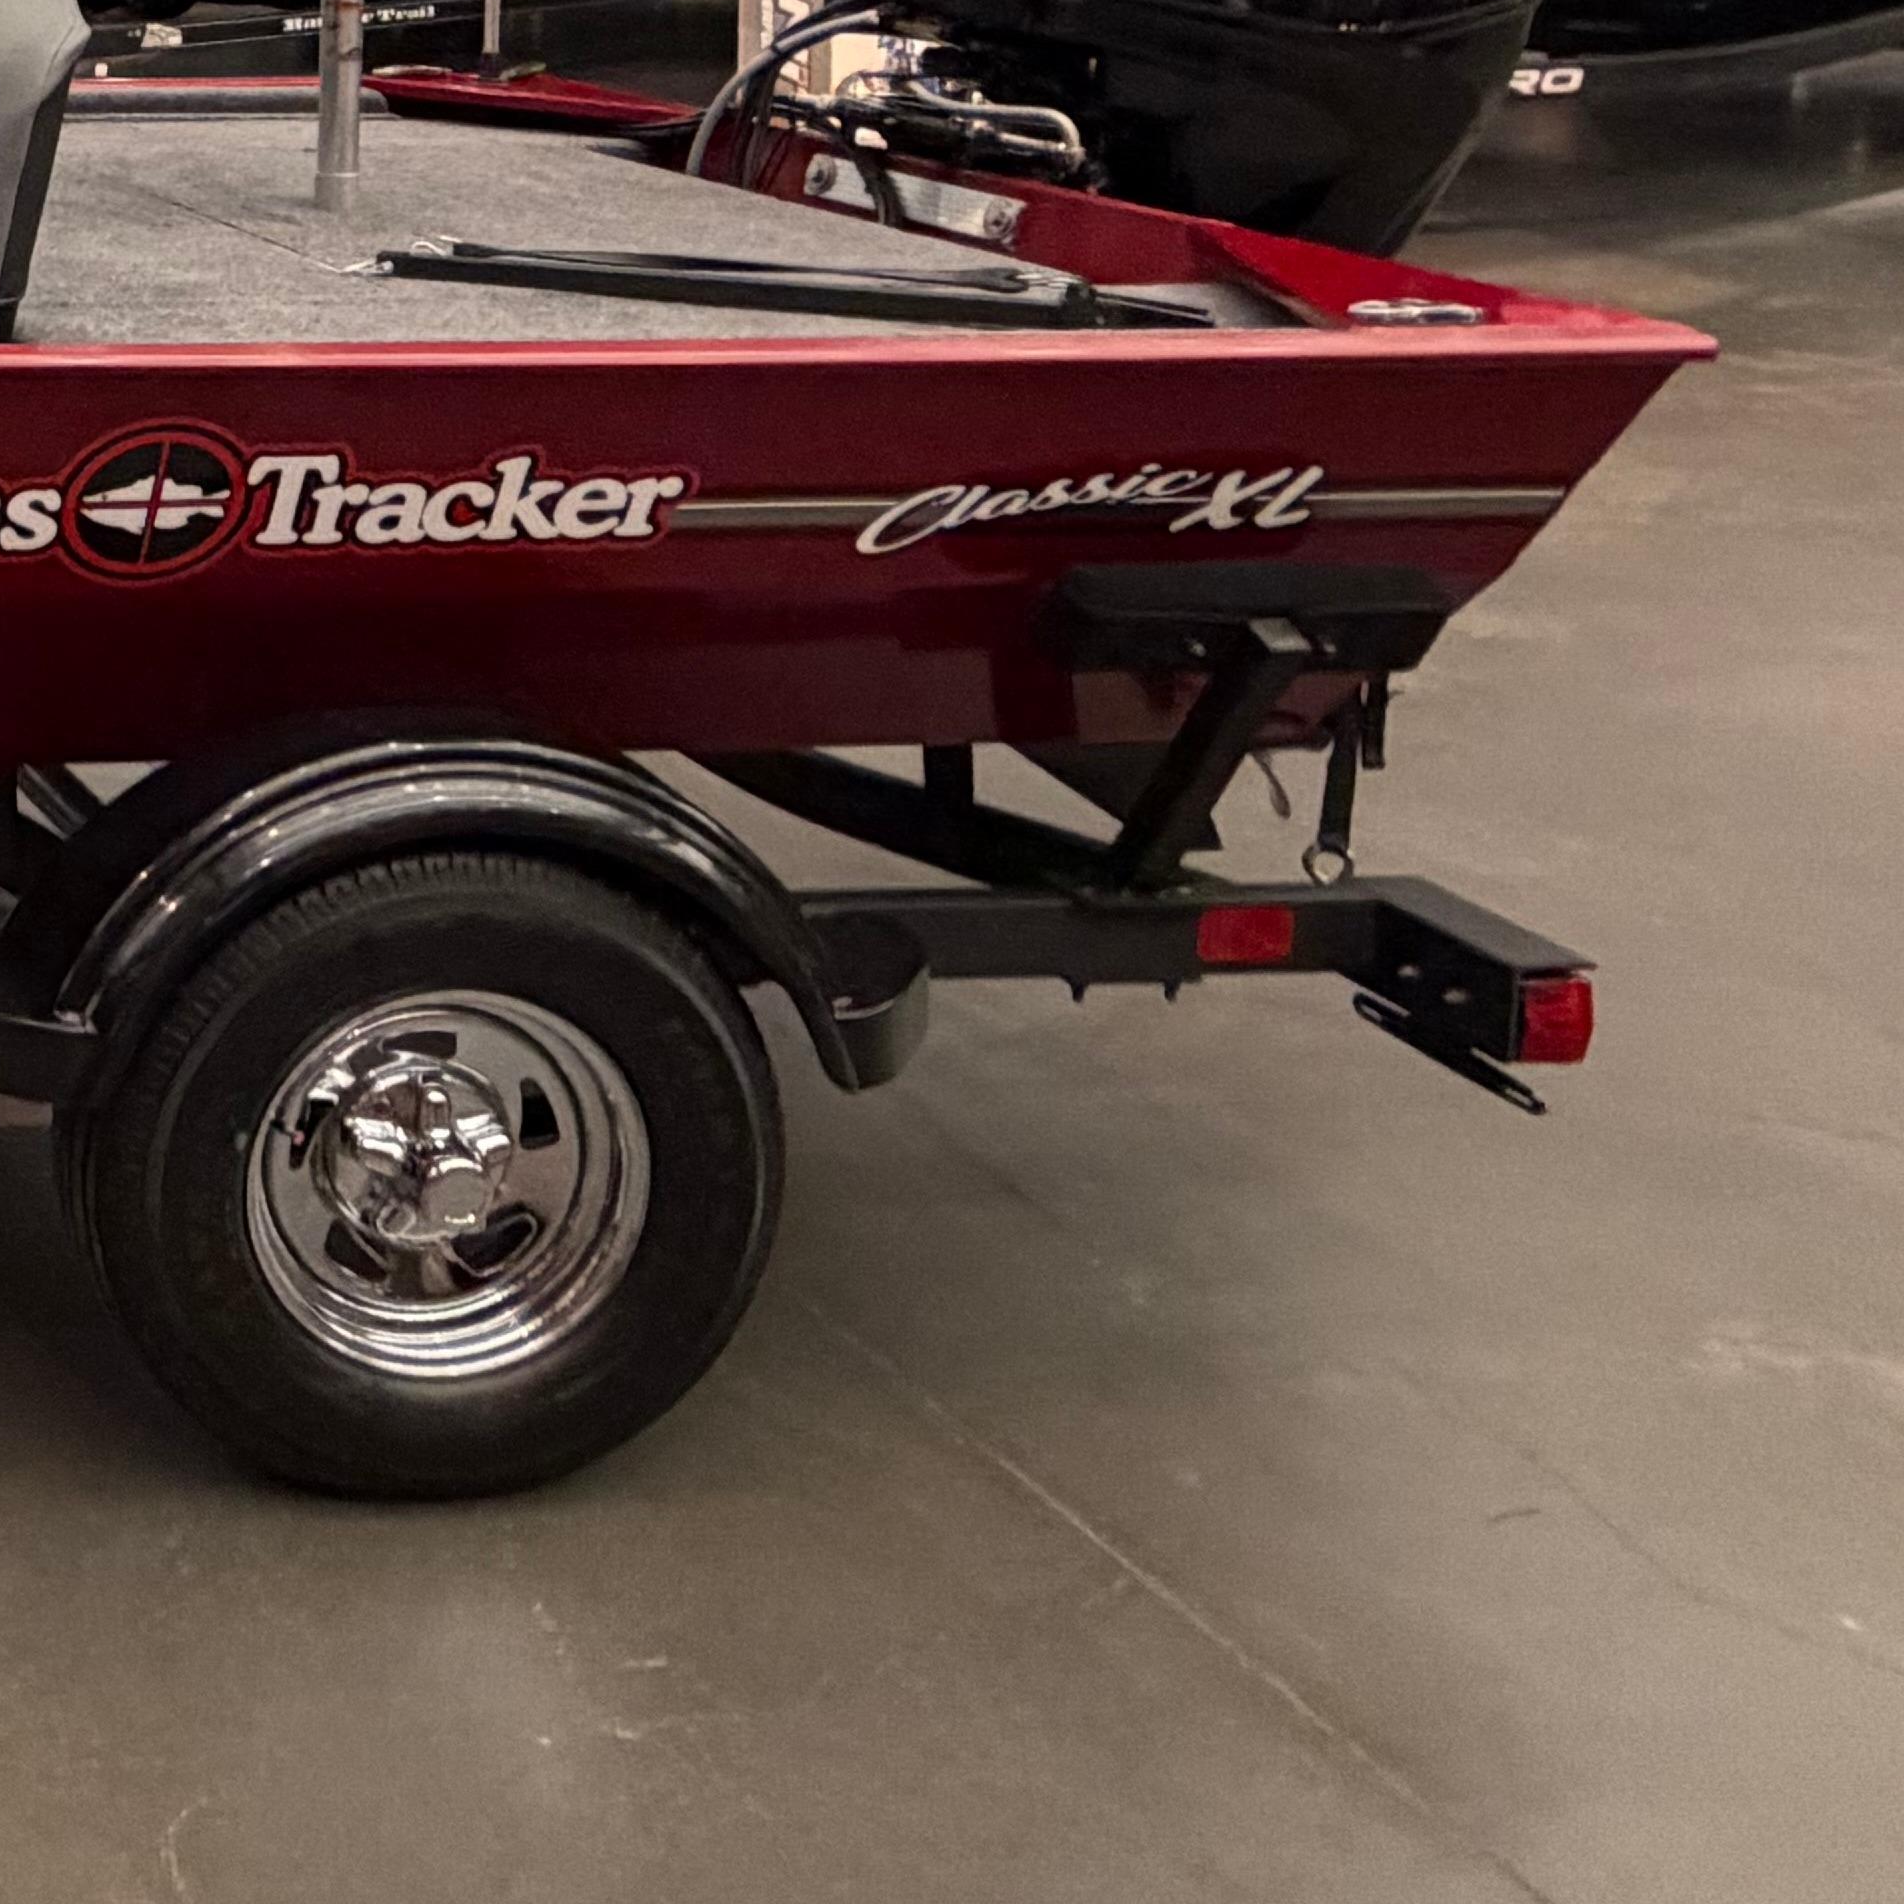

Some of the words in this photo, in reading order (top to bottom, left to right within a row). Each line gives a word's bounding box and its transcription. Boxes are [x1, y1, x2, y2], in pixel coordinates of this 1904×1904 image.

[247, 453, 685, 548] Tracker
[855, 462, 1213, 555] Classic
[1169, 464, 1324, 534] XL
